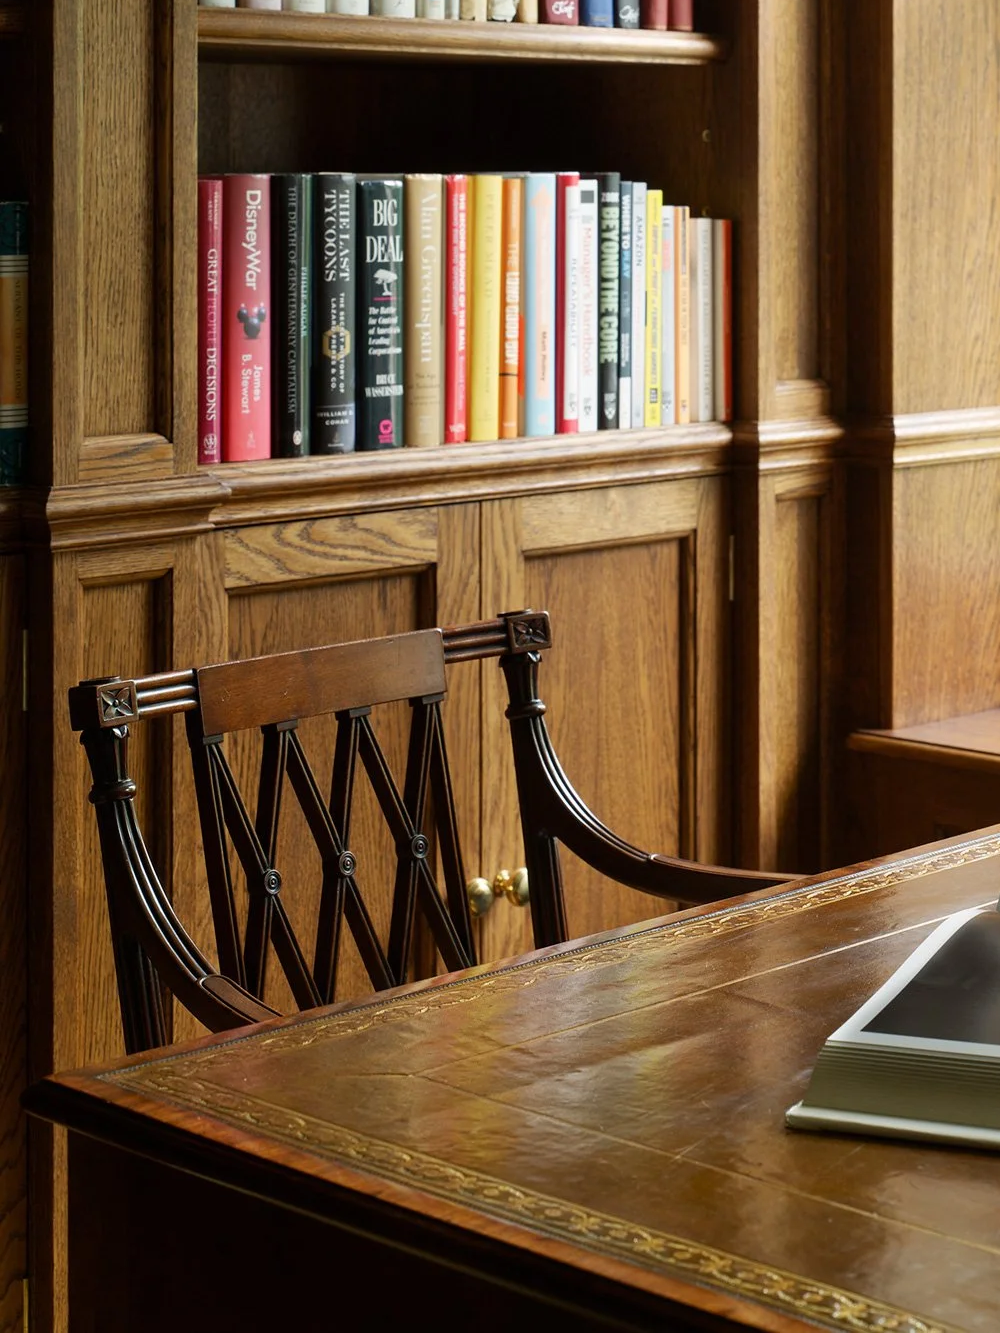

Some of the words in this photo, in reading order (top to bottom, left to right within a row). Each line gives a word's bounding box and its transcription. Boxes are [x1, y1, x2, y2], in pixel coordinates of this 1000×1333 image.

[287, 186, 298, 208] THE
[339, 188, 351, 229] THE
[372, 198, 399, 227] BIG
[421, 191, 439, 239] Alan
[459, 193, 467, 209] THE
[621, 194, 632, 233] WHERE
[241, 188, 263, 292] DisneyWar
[287, 211, 298, 247] DEATH
[324, 189, 338, 283] TYCOONS
[459, 211, 467, 252] SECOND
[600, 206, 620, 279] BEYOND
[621, 233, 632, 250] TO
[635, 215, 644, 268] AMAZON
[287, 250, 298, 266] OF
[339, 233, 351, 282] LAST
[365, 235, 404, 263] DEAL
[507, 241, 519, 268] THE
[580, 227, 593, 299] Manager's
[621, 250, 632, 279] PLAY
[207, 247, 219, 294] GREAT
[300, 266, 309, 304] PHILIP
[459, 253, 467, 292] BOUNCE
[506, 270, 520, 303] LONG
[287, 268, 298, 346] GENTLEMANLY
[415, 244, 437, 363] Greenspan
[459, 294, 467, 308] OF
[600, 279, 620, 315] THE
[206, 297, 218, 345] PEOPLE
[300, 305, 308, 338] AUGAR
[459, 309, 467, 327] THE
[241, 353, 253, 365] B.
[458, 328, 466, 352] BALL
[581, 303, 595, 376] Handbook
[600, 315, 620, 364] CORE
[205, 346, 218, 421] DECISIONS
[241, 368, 253, 414] Stewart
[253, 364, 264, 401] James
[287, 349, 298, 415] CAPITALISM
[339, 382, 346, 394] OF
